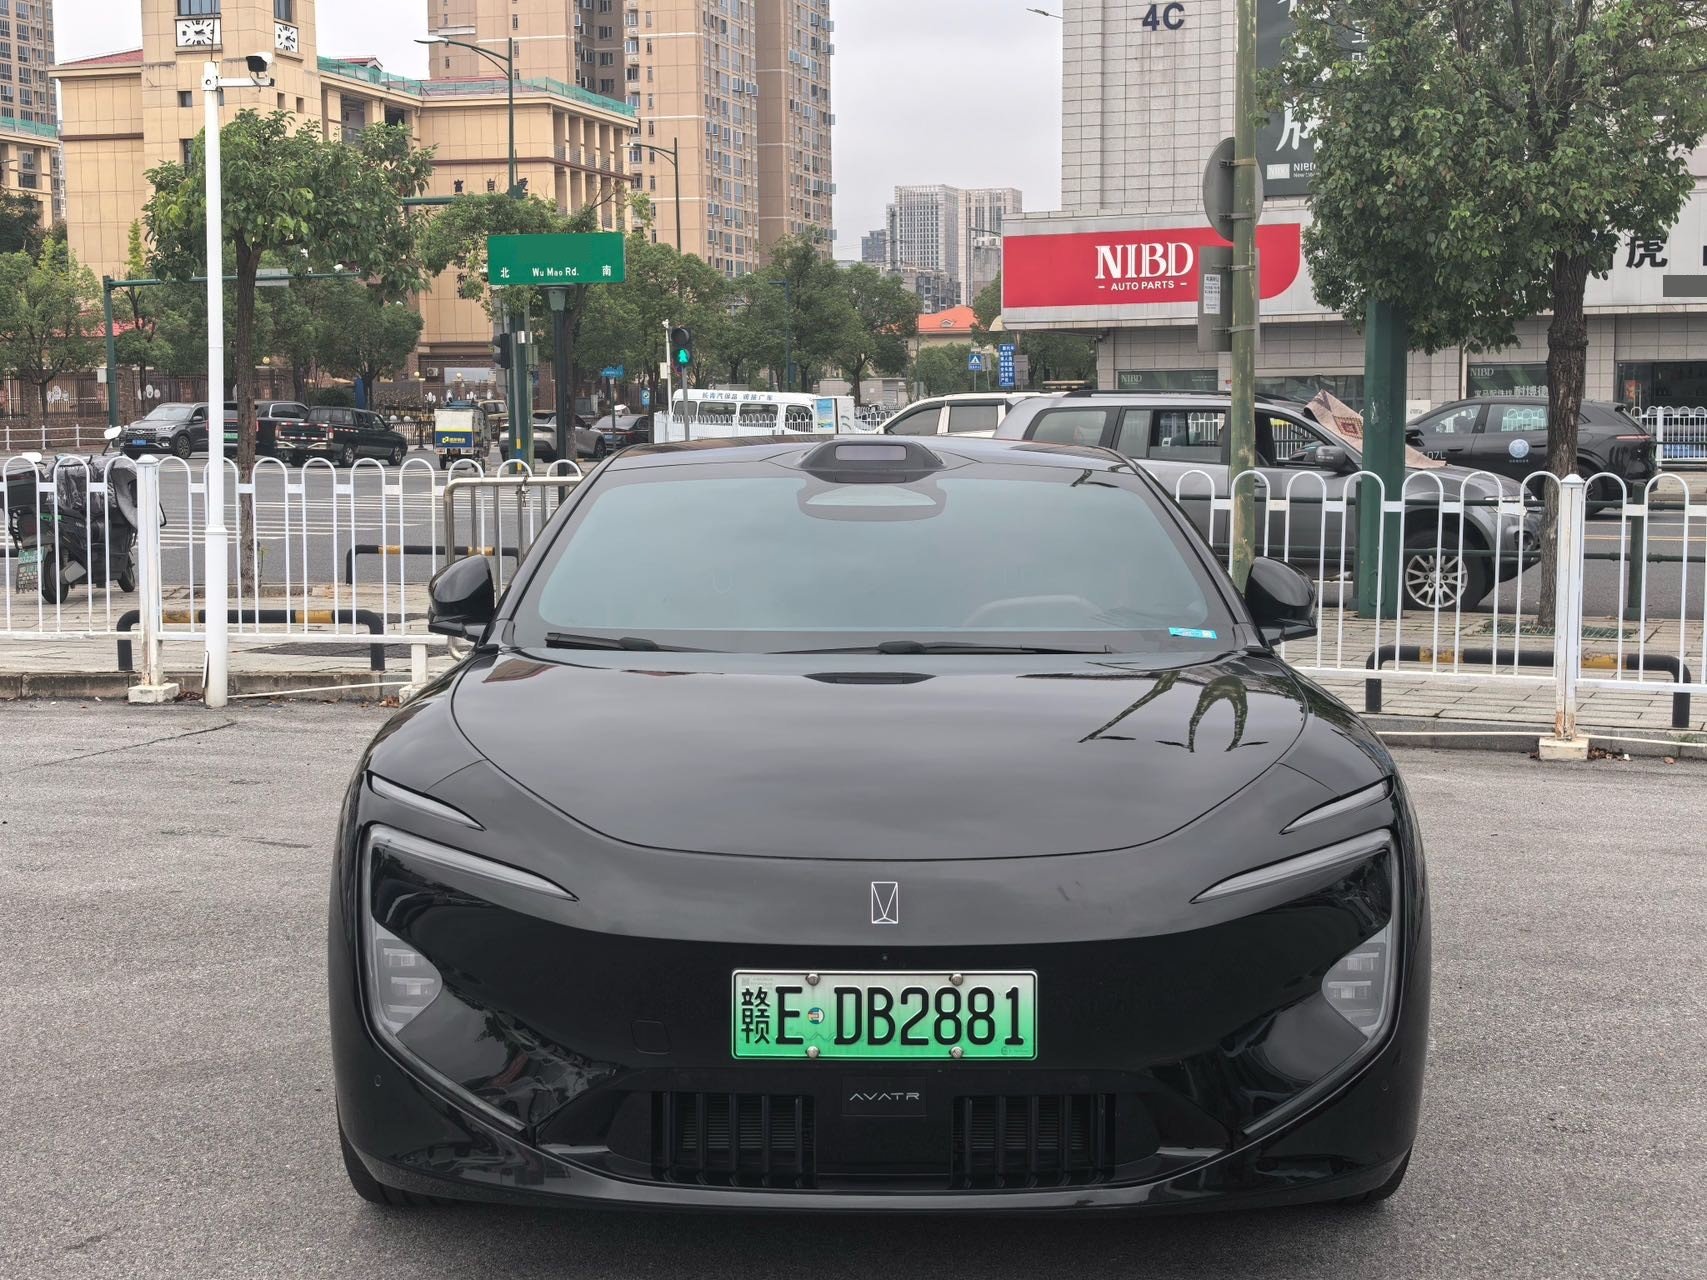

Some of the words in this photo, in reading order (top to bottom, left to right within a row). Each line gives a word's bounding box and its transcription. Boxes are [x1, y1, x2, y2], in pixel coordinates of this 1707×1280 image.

[1142, 2, 1185, 31] 4C
[1095, 242, 1194, 279] NIBD
[500, 267, 510, 279] 北
[532, 267, 545, 277] Wu
[547, 267, 563, 277] Mao
[565, 266, 580, 276] Rd.
[602, 264, 612, 277] 南
[1110, 282, 1139, 291] AUTO
[1141, 280, 1175, 290] PARTS
[1470, 367, 1494, 377] NIBD
[1120, 374, 1143, 383] NIBD
[741, 986, 804, 1045] 赣E
[834, 986, 1024, 1045] DB2881
[849, 1092, 920, 1101] AVATR
